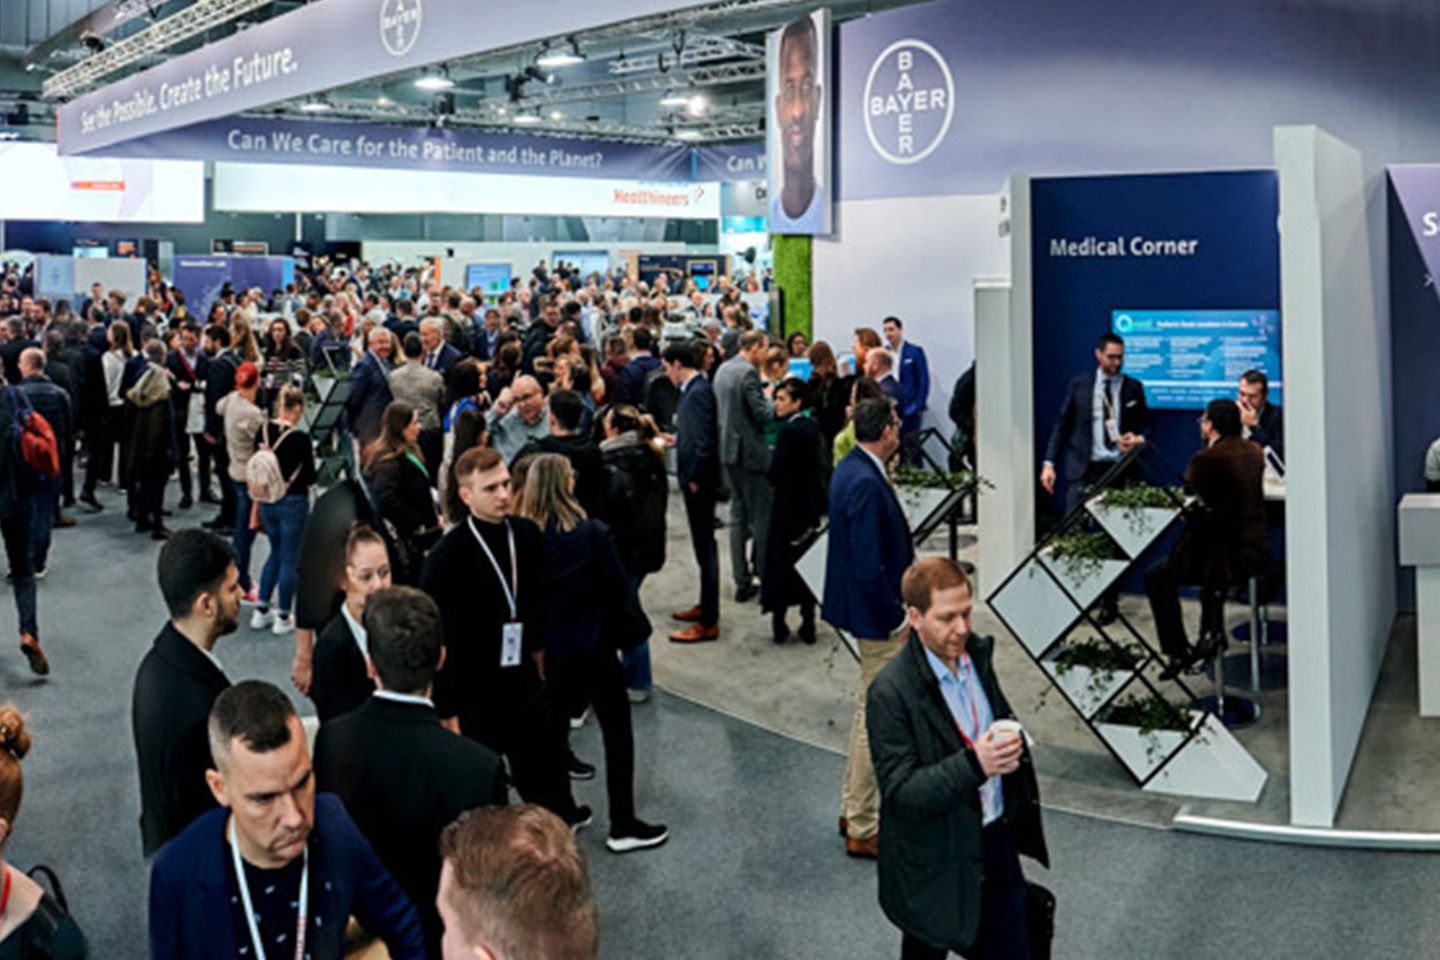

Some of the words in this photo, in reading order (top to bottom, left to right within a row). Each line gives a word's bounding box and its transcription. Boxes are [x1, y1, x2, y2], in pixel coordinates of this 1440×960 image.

[160, 76, 202, 112] Create
[205, 63, 230, 98] the
[232, 46, 299, 90] Future.
[870, 87, 946, 117] BAYER
[227, 129, 266, 151] Can
[271, 130, 303, 152] We
[308, 132, 352, 155] Care
[357, 134, 383, 157] for
[388, 137, 418, 158] the
[422, 141, 483, 163] Patient
[486, 146, 518, 164] and
[520, 147, 546, 166] the
[548, 149, 604, 169] Planet?
[1049, 237, 1126, 257] Medical
[1129, 236, 1199, 256] Corner
